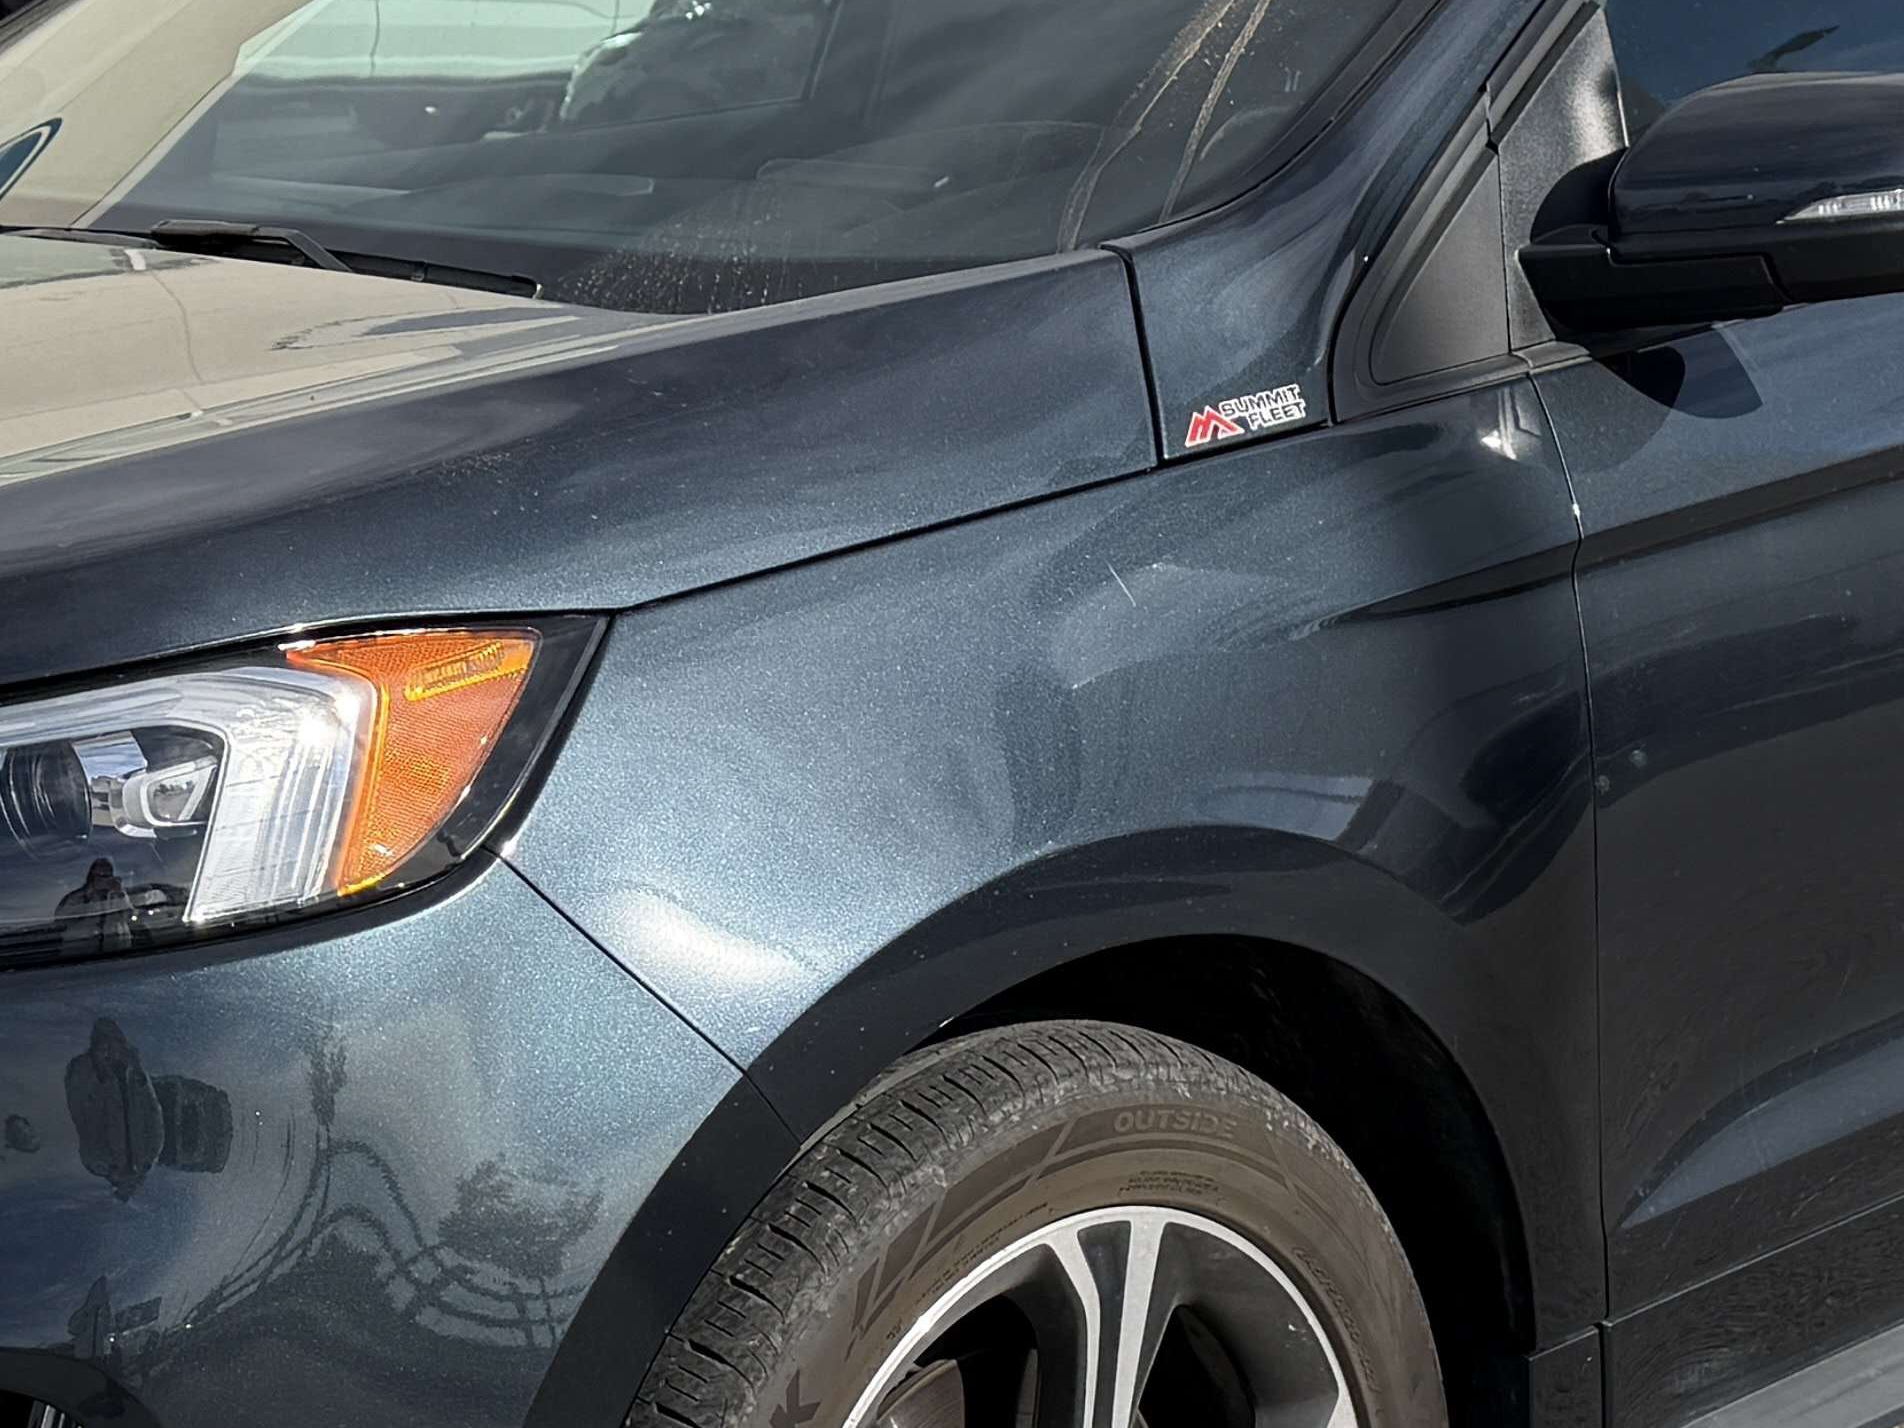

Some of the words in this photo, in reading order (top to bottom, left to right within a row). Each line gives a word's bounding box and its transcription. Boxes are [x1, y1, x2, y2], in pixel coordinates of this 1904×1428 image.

[1220, 386, 1299, 417] SUMMIT
[1248, 402, 1304, 427] FLEET
[1111, 1105, 1240, 1142] OUTSIDE
